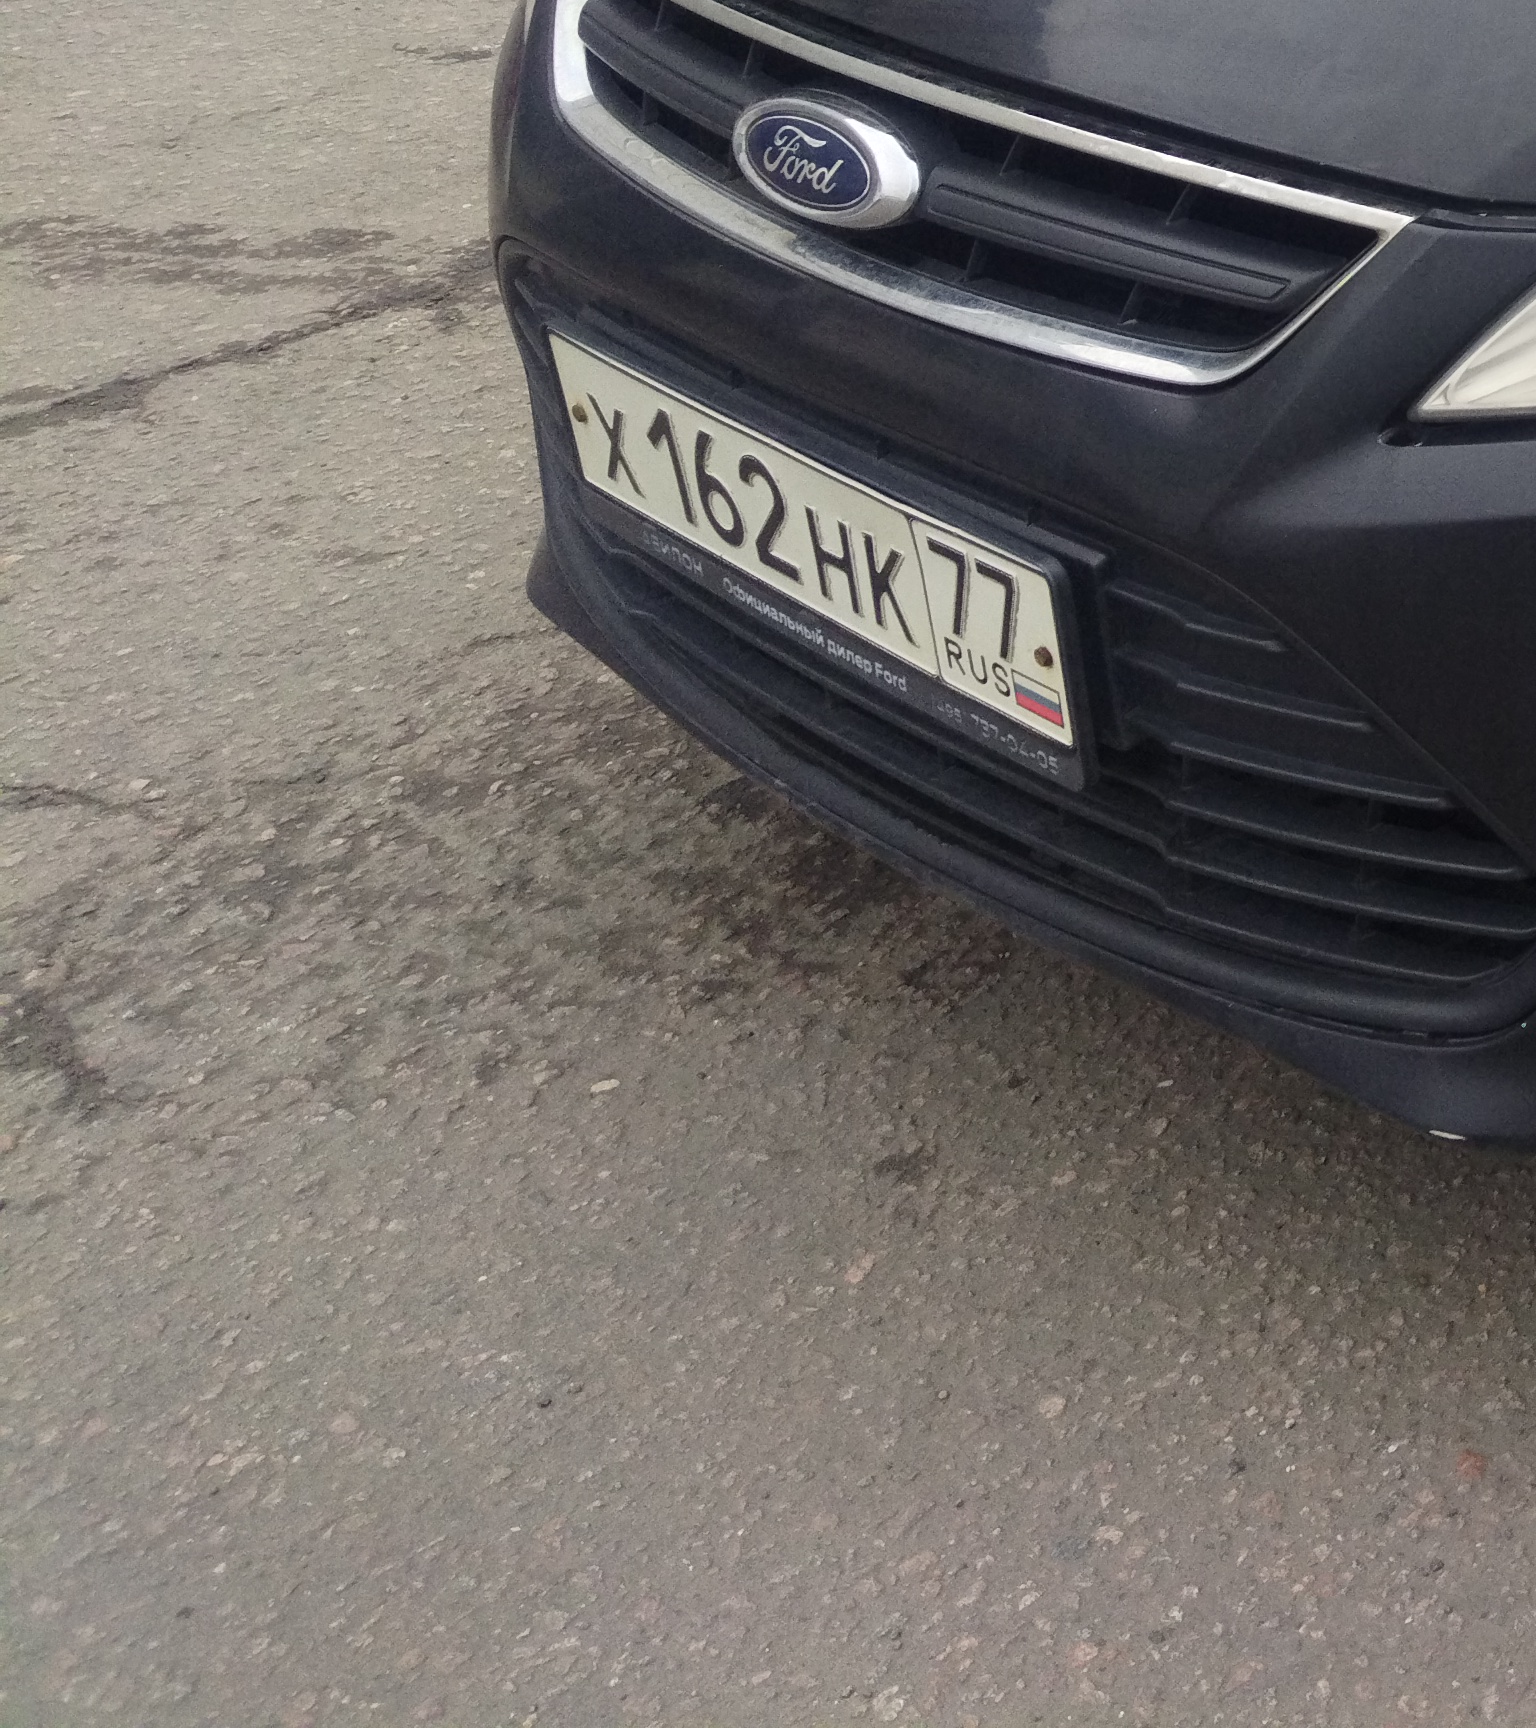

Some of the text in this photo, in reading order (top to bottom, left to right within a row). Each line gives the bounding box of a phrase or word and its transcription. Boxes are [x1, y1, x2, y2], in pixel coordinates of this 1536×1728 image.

[763, 125, 844, 194] Ford
[722, 576, 826, 646] Официальный
[827, 640, 873, 675] дилер
[874, 663, 908, 693] Ford
[927, 536, 1020, 663] 77
[944, 636, 1011, 698] RUS
